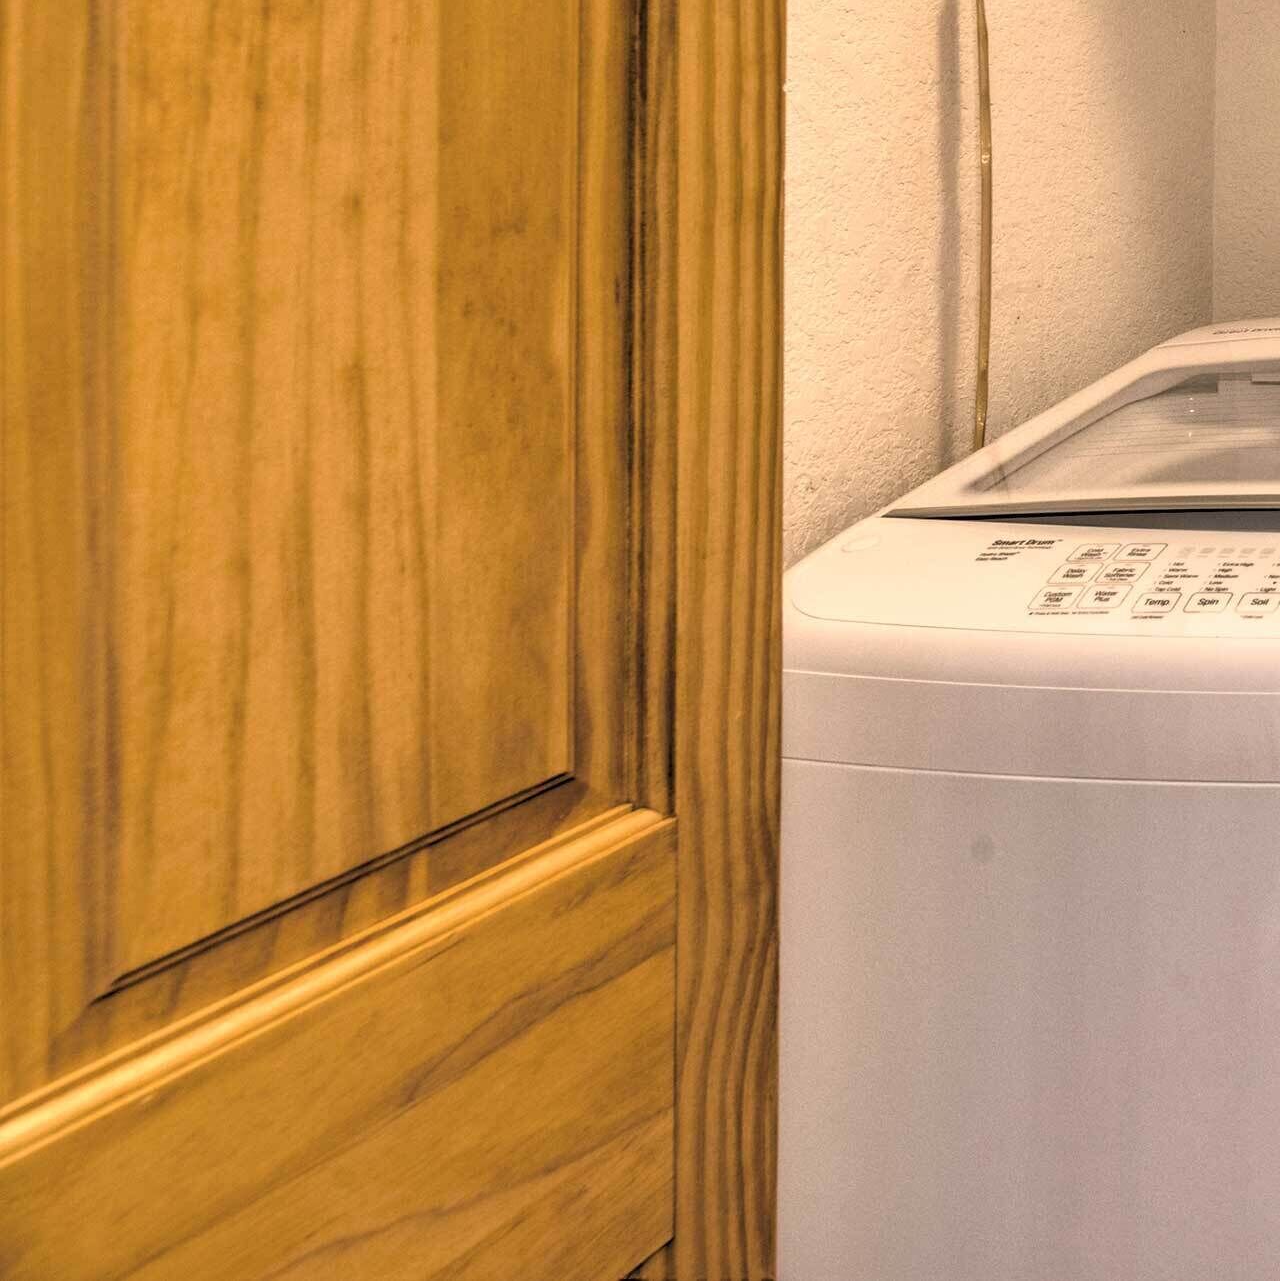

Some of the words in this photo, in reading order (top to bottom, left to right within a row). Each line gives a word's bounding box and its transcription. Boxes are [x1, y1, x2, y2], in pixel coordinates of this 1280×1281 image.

[1144, 598, 1170, 607] Temp
[1197, 597, 1220, 608] Spin
[1250, 597, 1270, 607] Soil
